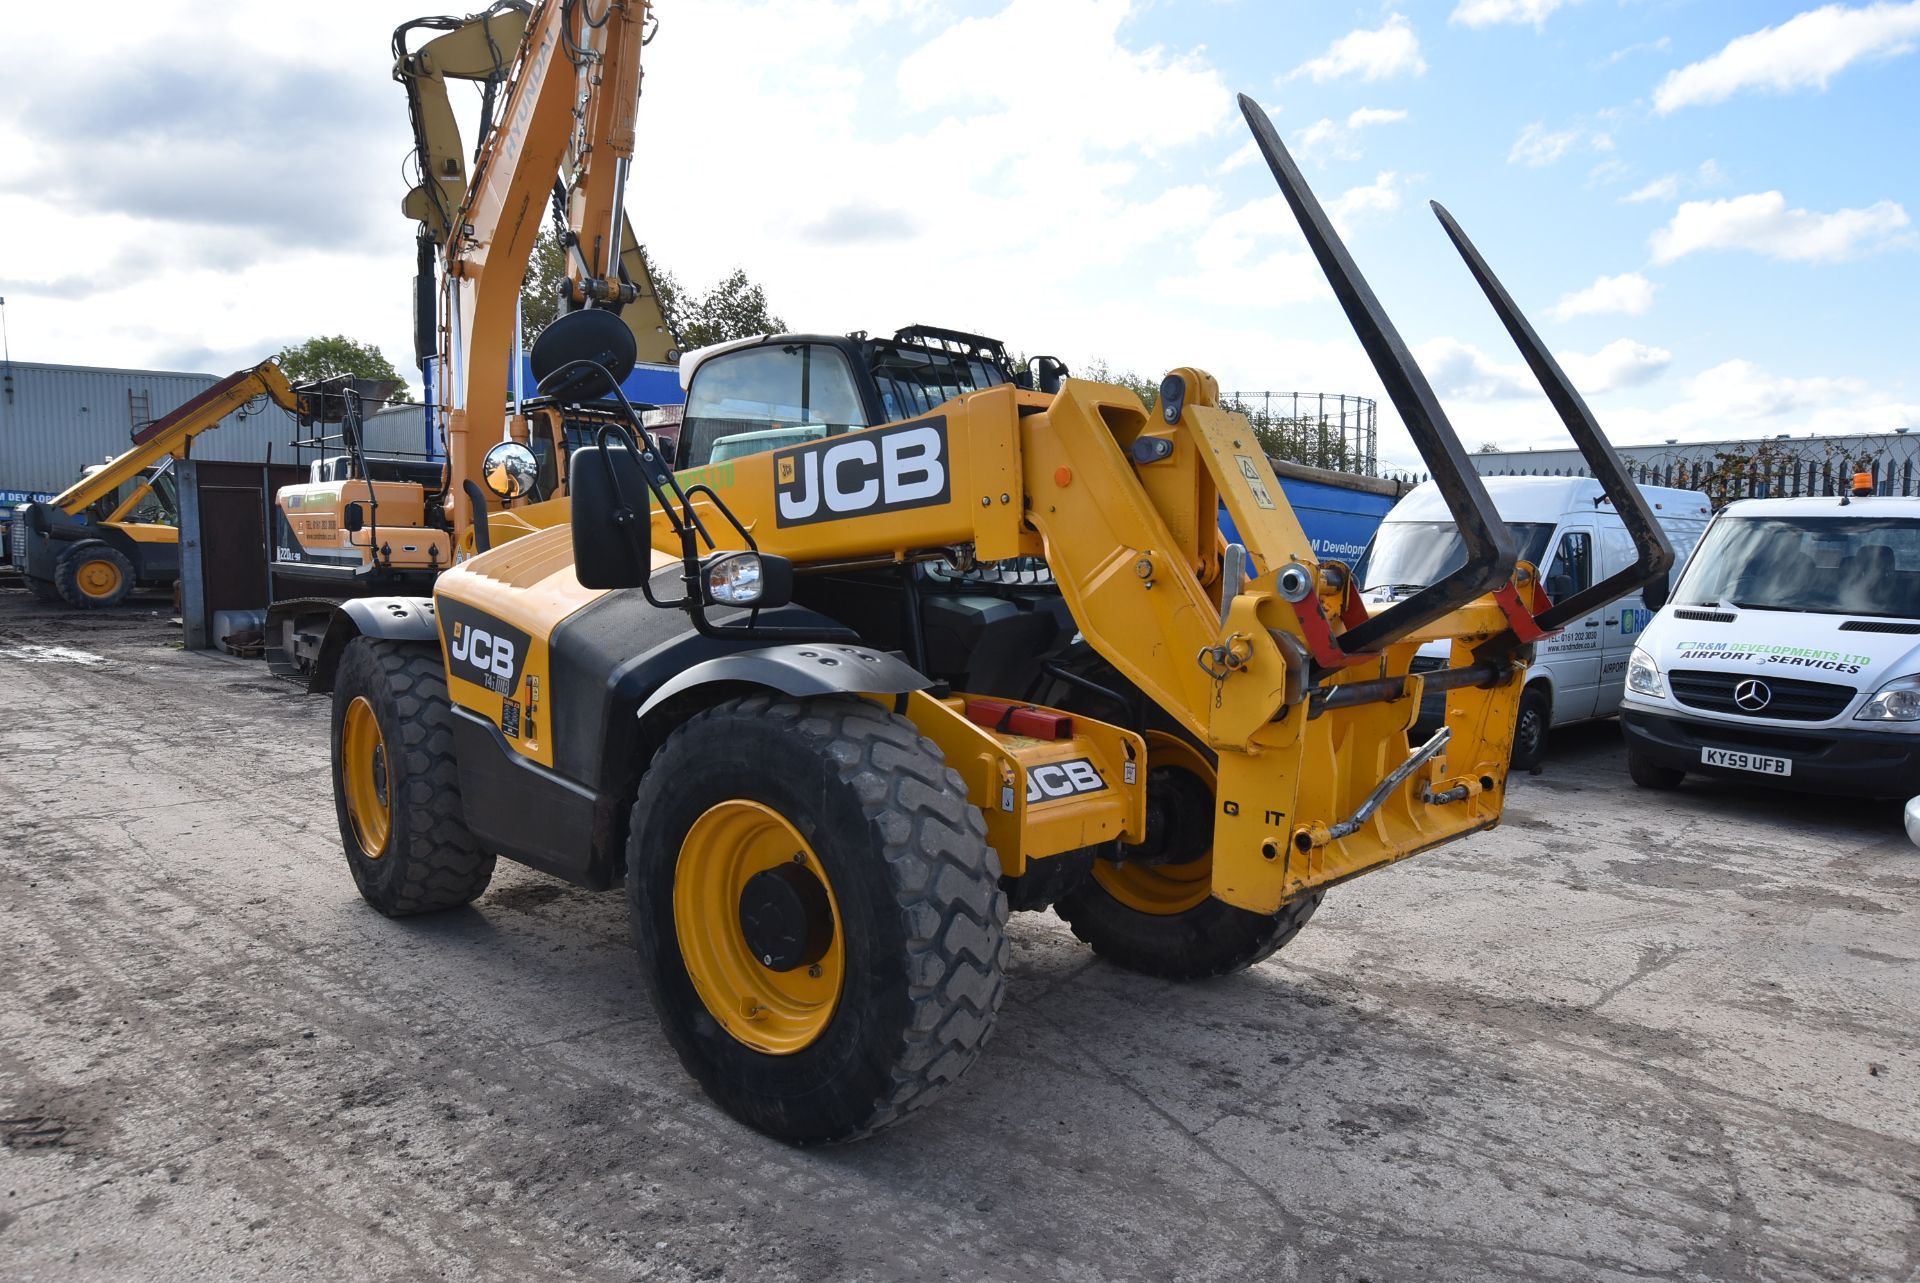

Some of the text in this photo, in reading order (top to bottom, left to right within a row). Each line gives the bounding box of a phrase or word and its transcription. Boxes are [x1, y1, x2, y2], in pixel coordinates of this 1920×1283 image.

[506, 28, 554, 160] HYUNDAI
[779, 427, 944, 520] JCB
[8, 492, 56, 503] DEVLOP
[1575, 632, 1584, 641] 202
[452, 625, 514, 679] JCB
[1680, 651, 1861, 674] AIRPORT SERVICES
[1696, 642, 1871, 666] R&M DEVELOPMENTS LTD
[1603, 661, 1626, 674] AIRPORT
[1707, 750, 1785, 773] KY59 UFB
